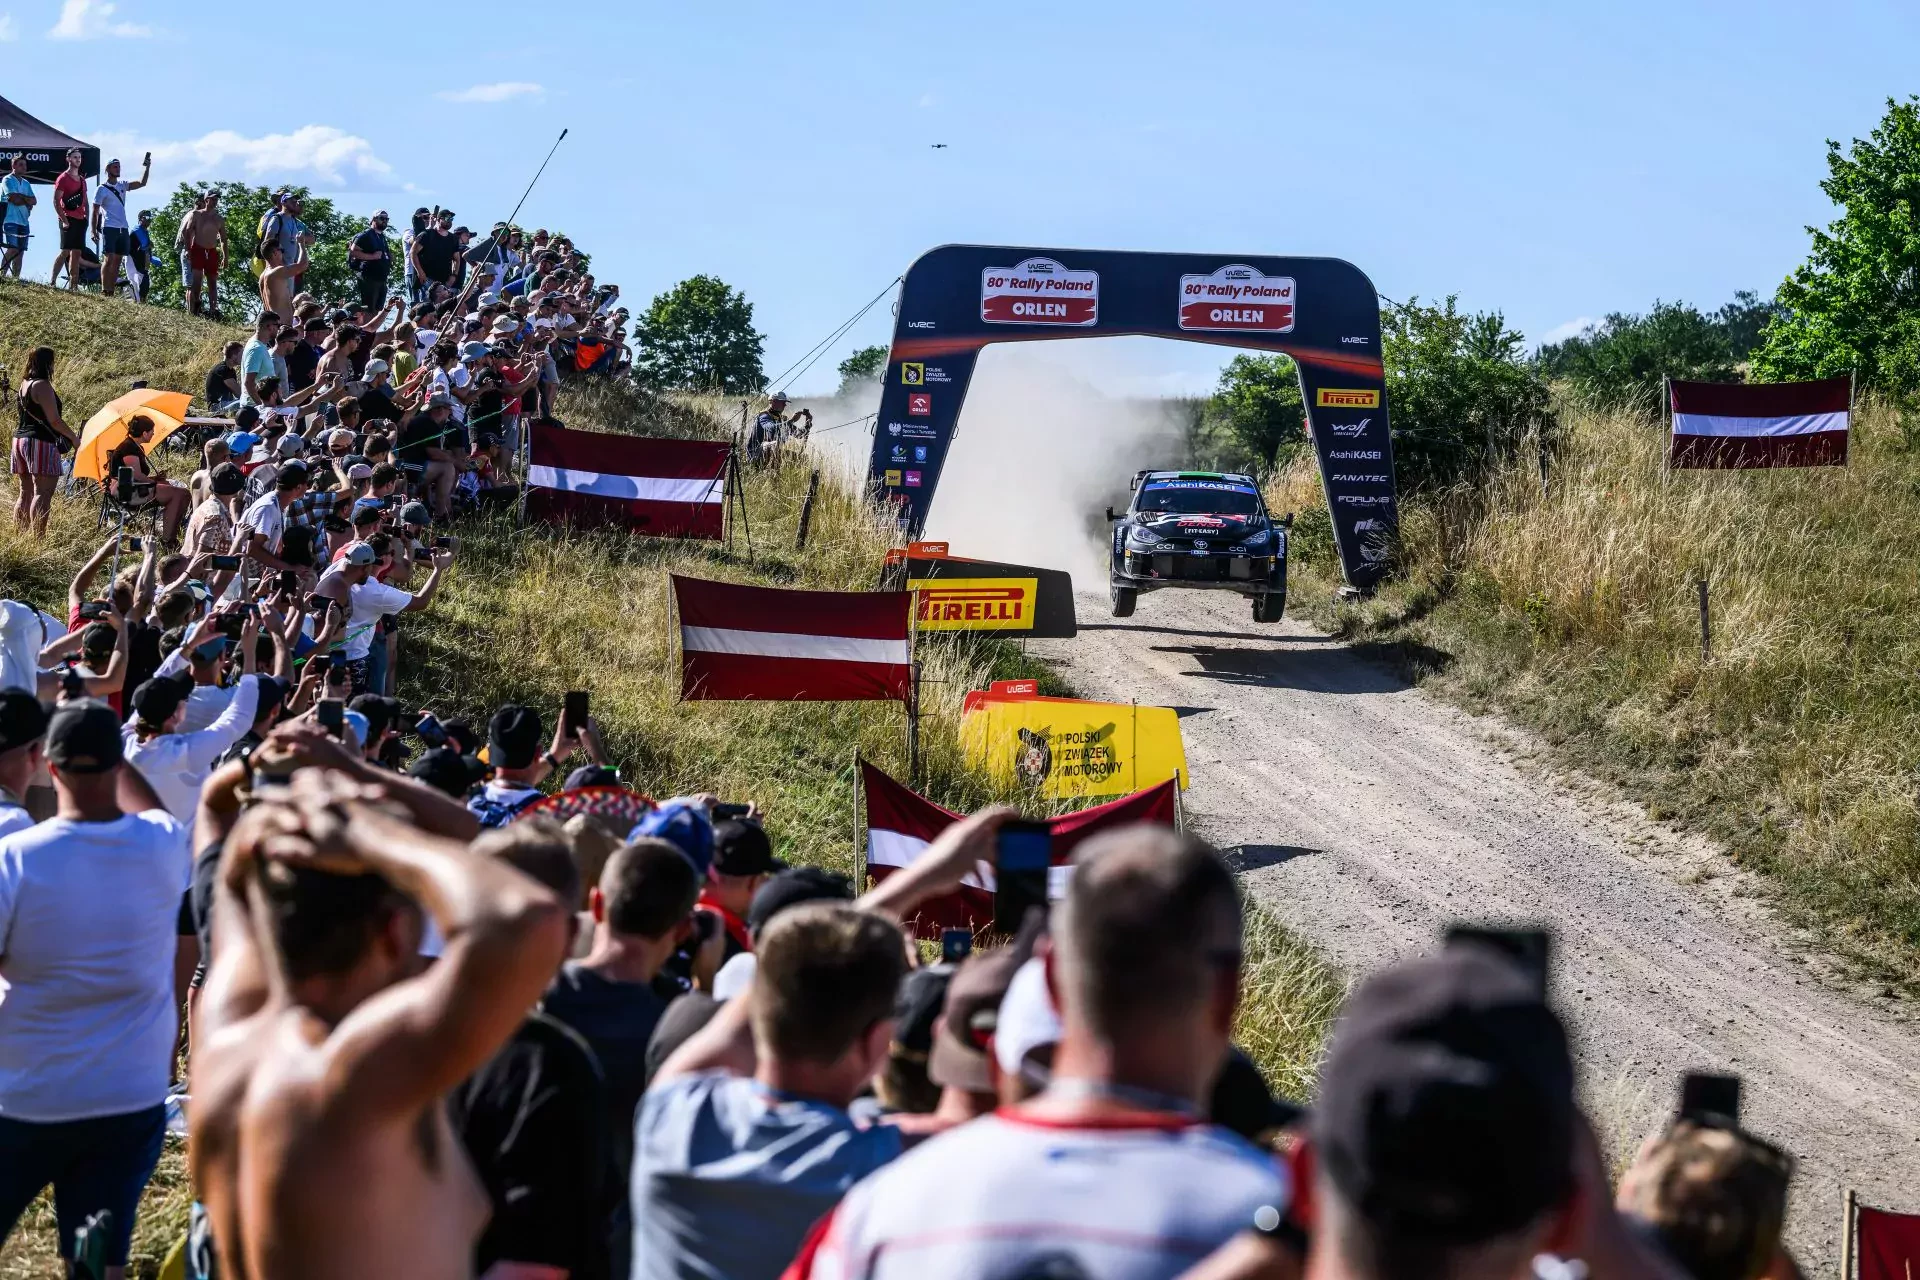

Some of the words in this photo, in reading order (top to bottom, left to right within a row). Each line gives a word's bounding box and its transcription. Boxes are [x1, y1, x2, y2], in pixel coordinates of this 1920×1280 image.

[1010, 277, 1044, 292] Rally
[1045, 279, 1094, 291] Poland
[1207, 284, 1242, 299] Rally
[1243, 285, 1291, 298] Poland
[1012, 302, 1067, 317] ORLEN
[1210, 308, 1264, 323] ORLEN
[908, 321, 936, 329] WRC
[1341, 336, 1369, 344] WRC
[1323, 392, 1374, 405] PIRELLI
[1330, 450, 1382, 460] AsahiKASEI
[1332, 474, 1388, 482] FANATEC
[1166, 482, 1236, 491] AsahiKASEI
[917, 588, 1025, 621] PIRELLI
[1007, 683, 1033, 694] WRC
[1065, 731, 1101, 744] POLSKI
[1065, 746, 1110, 762] ZWIĄZEK
[1064, 761, 1123, 777] MOTOROWY
